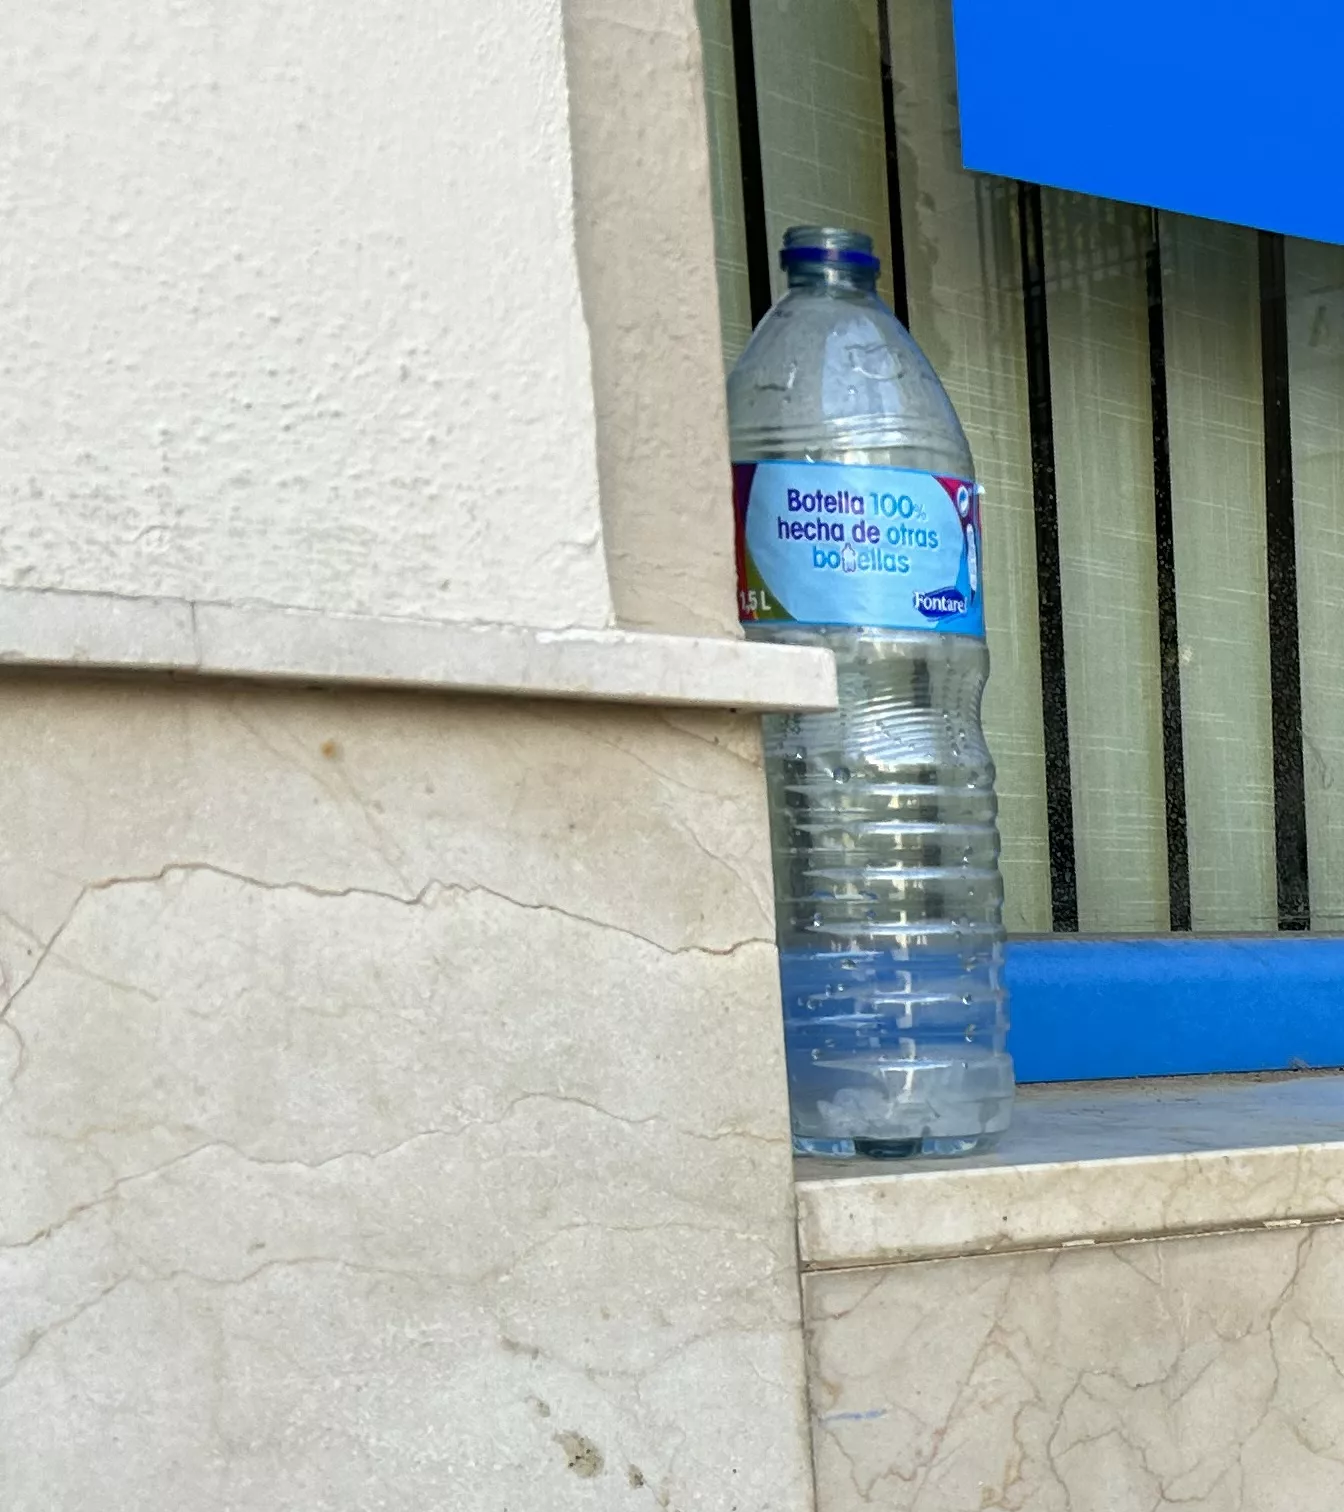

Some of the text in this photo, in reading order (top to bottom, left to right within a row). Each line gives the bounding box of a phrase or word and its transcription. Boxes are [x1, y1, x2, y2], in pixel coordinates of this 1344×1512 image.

[787, 488, 927, 521] Botella 100%
[777, 515, 939, 549] hecha de otras
[760, 590, 772, 611] L
[913, 591, 968, 614] Fontarel
